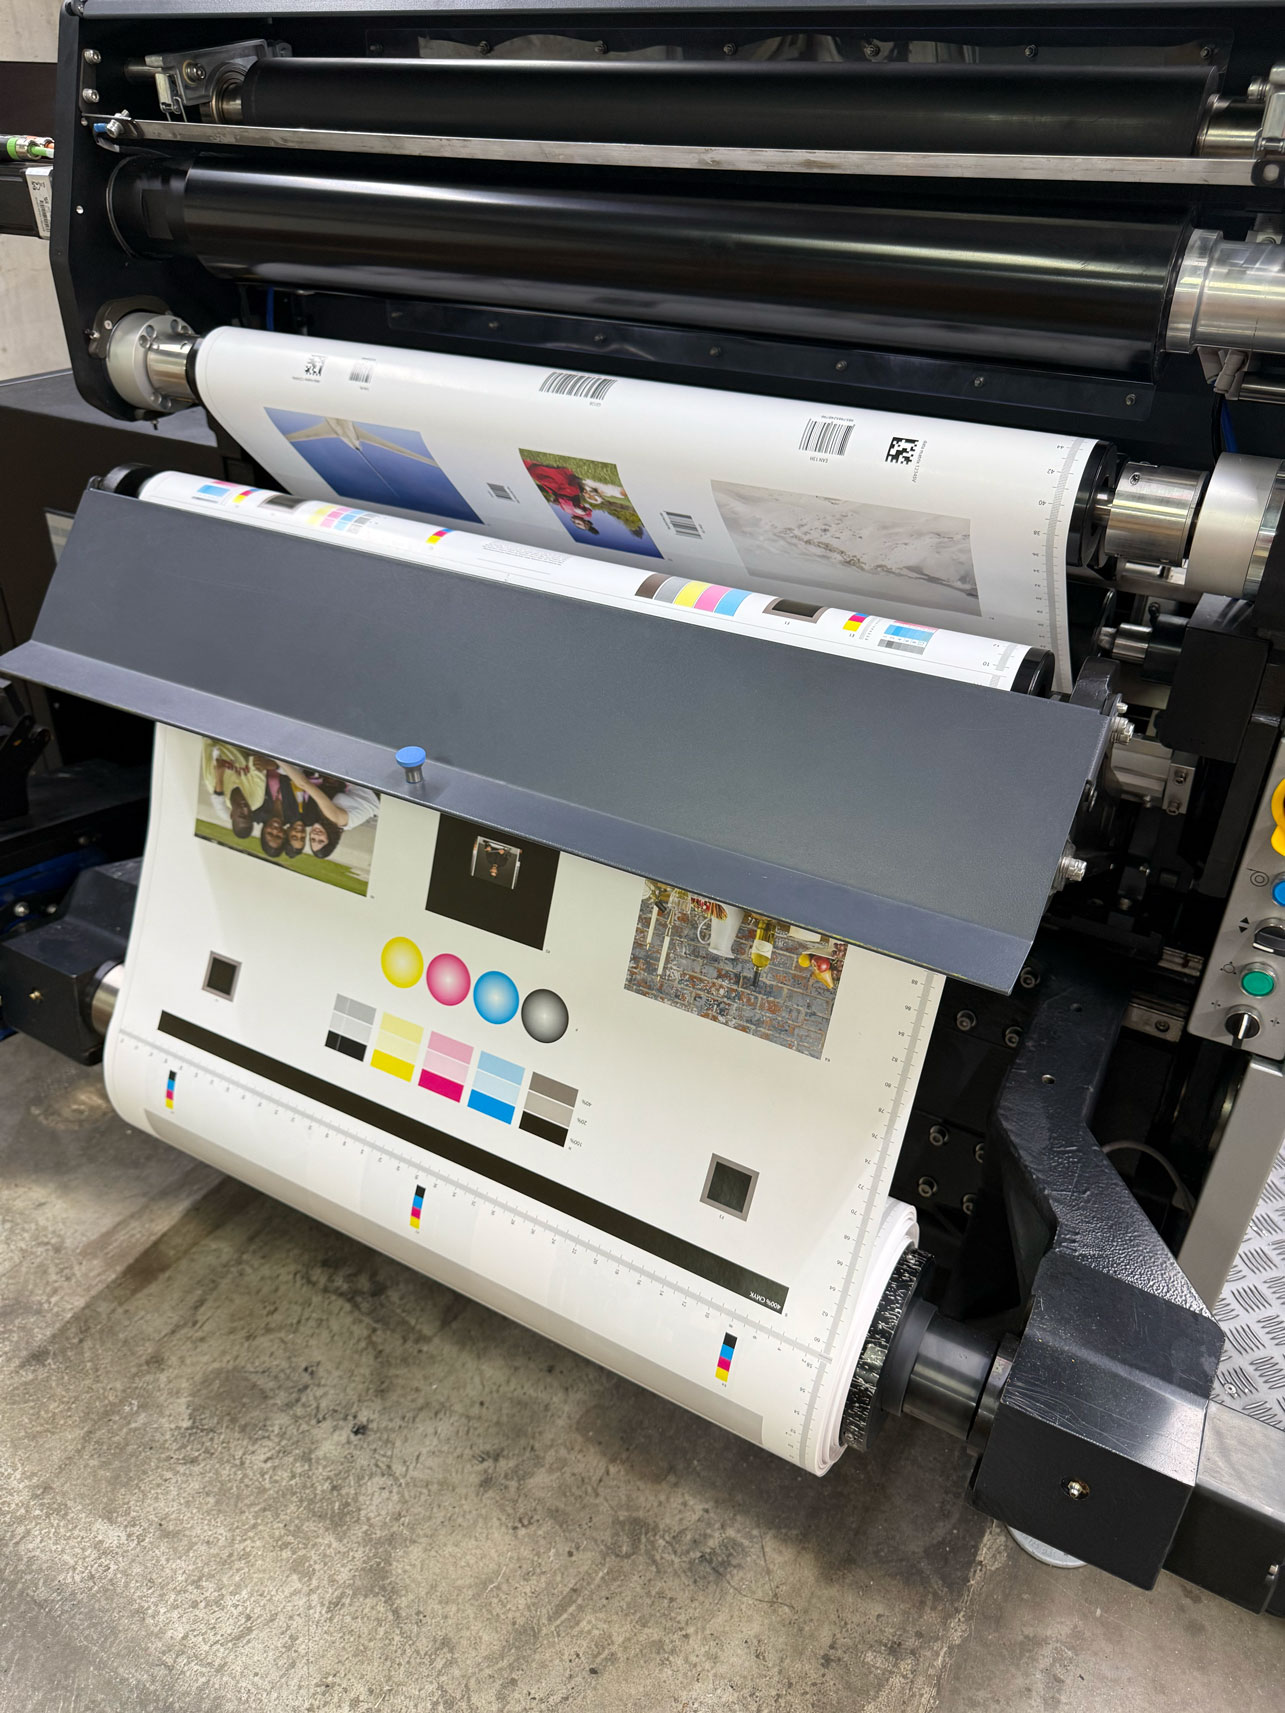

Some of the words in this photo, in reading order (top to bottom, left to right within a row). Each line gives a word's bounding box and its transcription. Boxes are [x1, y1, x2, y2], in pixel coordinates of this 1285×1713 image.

[911, 978, 919, 986] 88
[871, 1132, 878, 1140] 76
[850, 1208, 858, 1216] 70
[749, 1291, 766, 1303] CMYK
[766, 1298, 781, 1310] 400%
